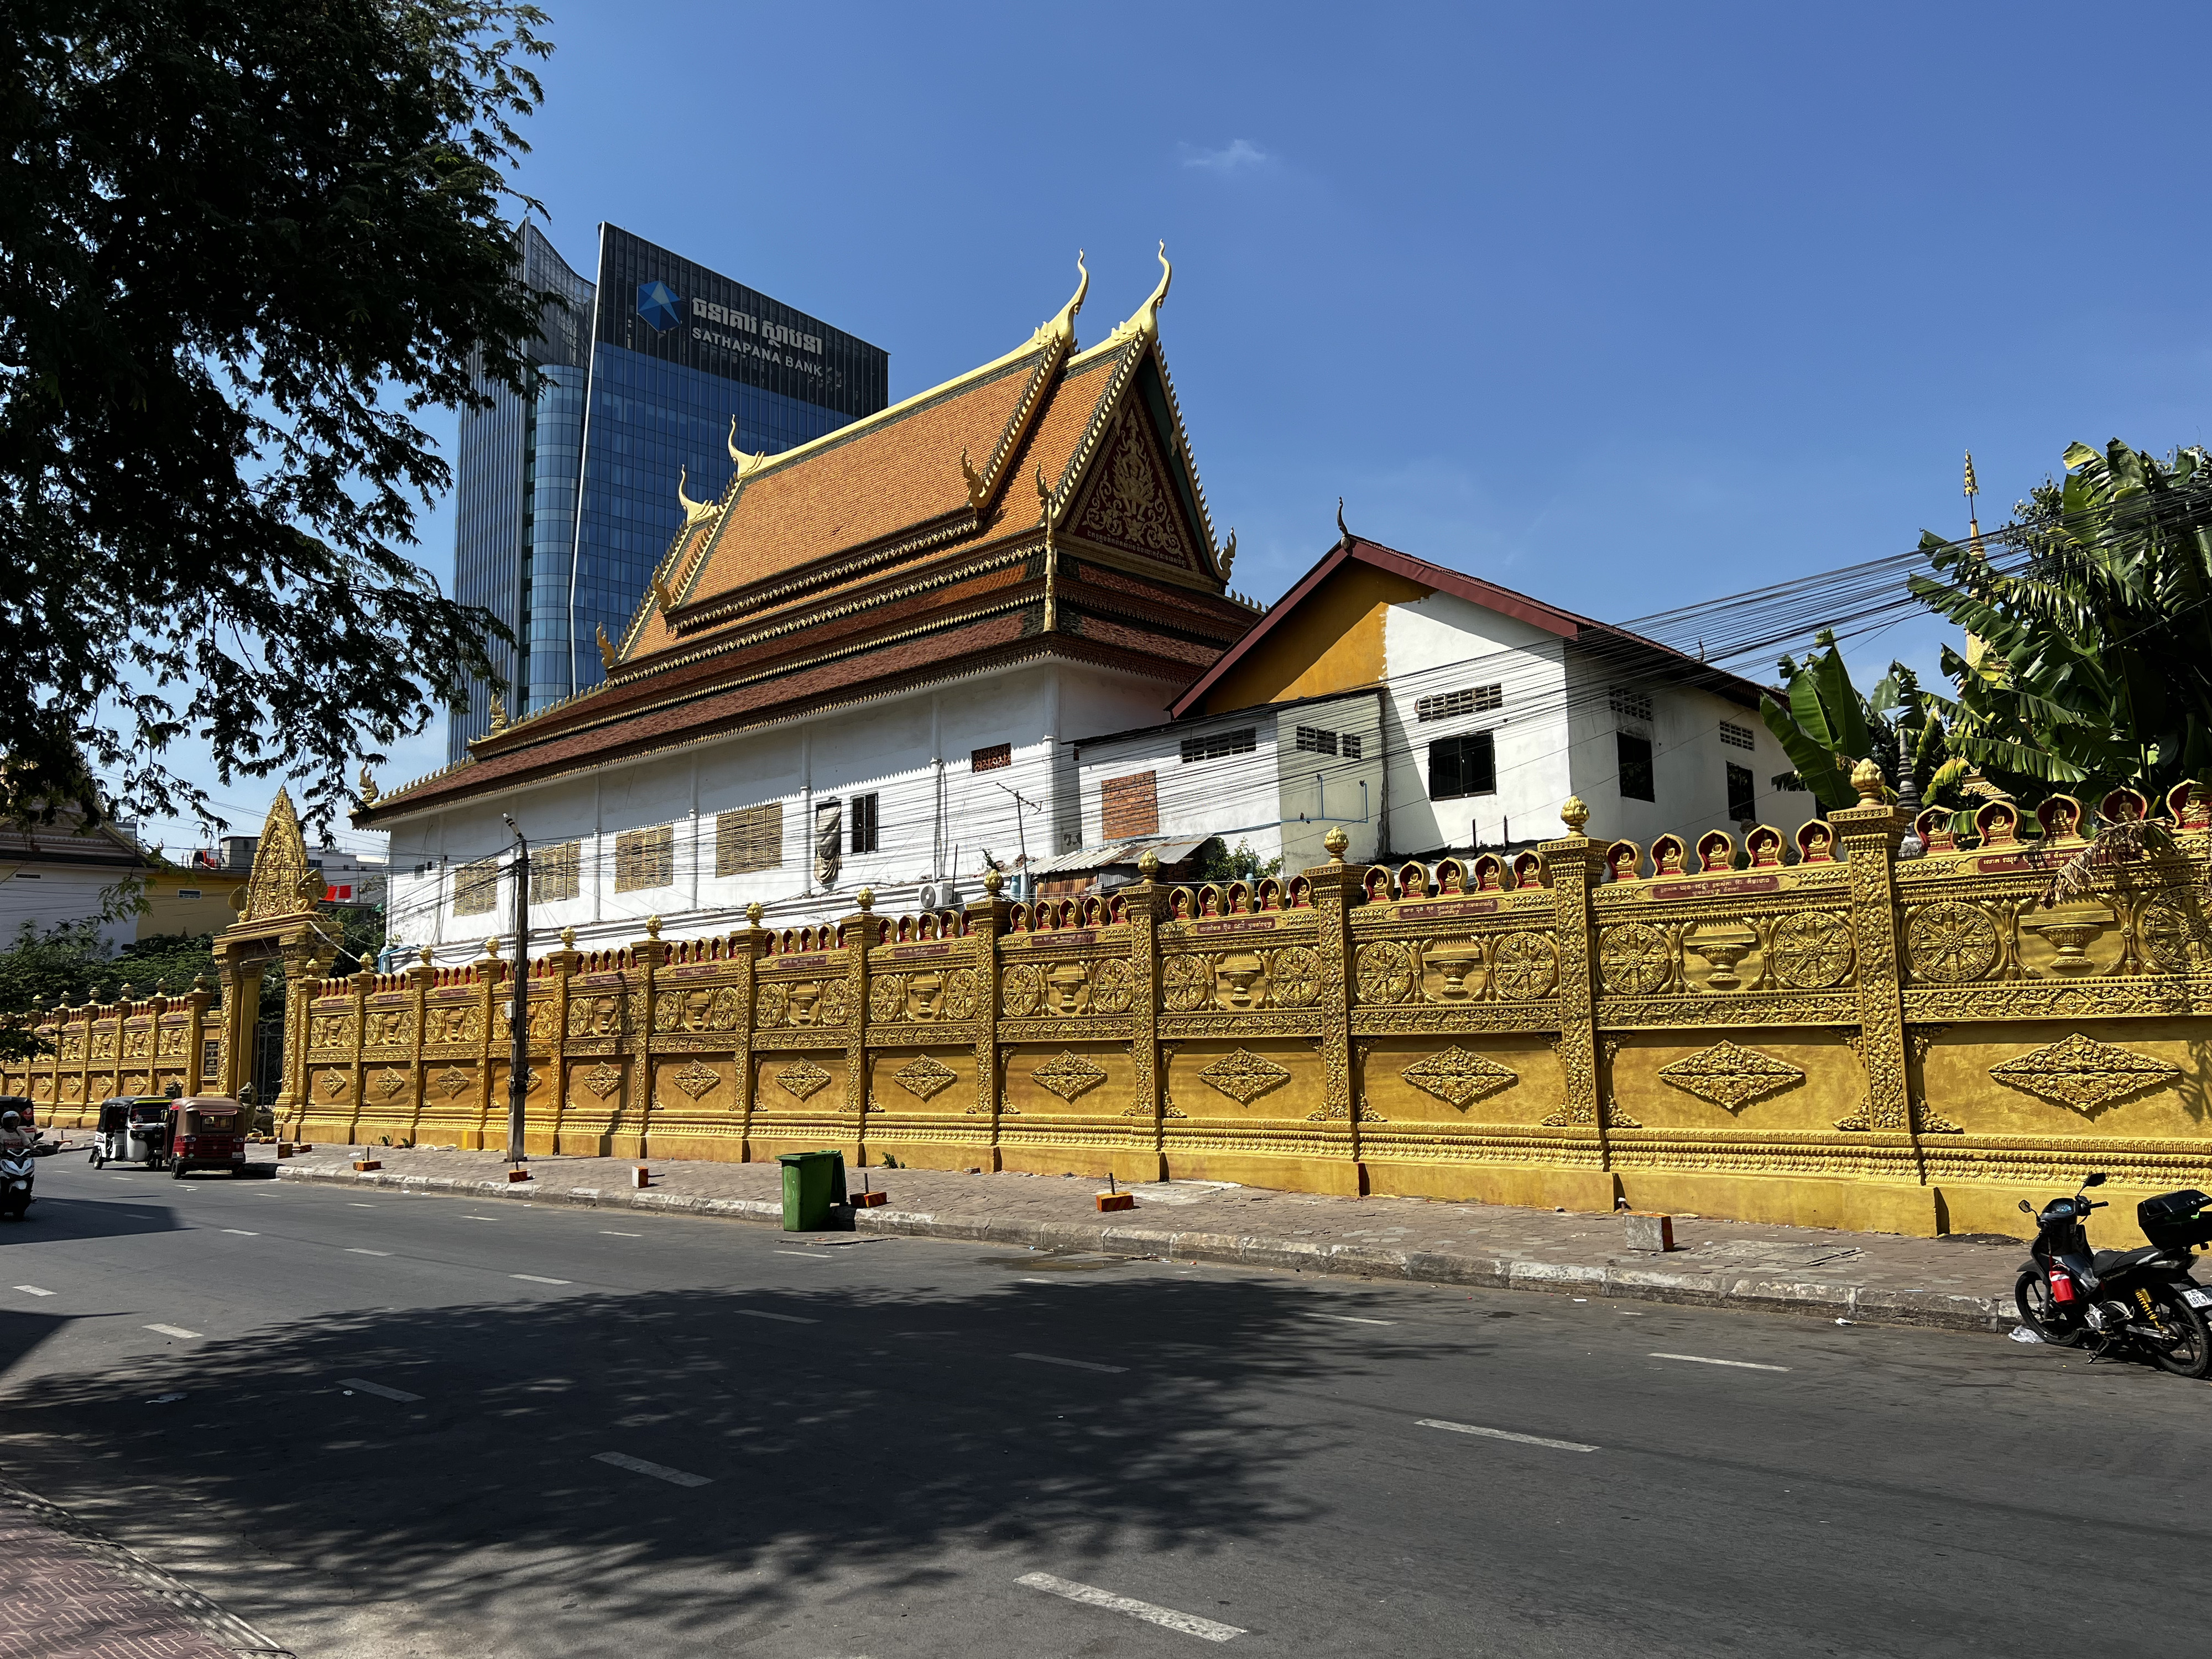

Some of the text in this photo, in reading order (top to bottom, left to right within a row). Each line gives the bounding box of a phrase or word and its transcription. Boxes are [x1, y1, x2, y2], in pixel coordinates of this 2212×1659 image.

[692, 297, 822, 356] ធនាគារ ស្ថាបនា
[692, 327, 823, 377] SATHAPANA BANK
